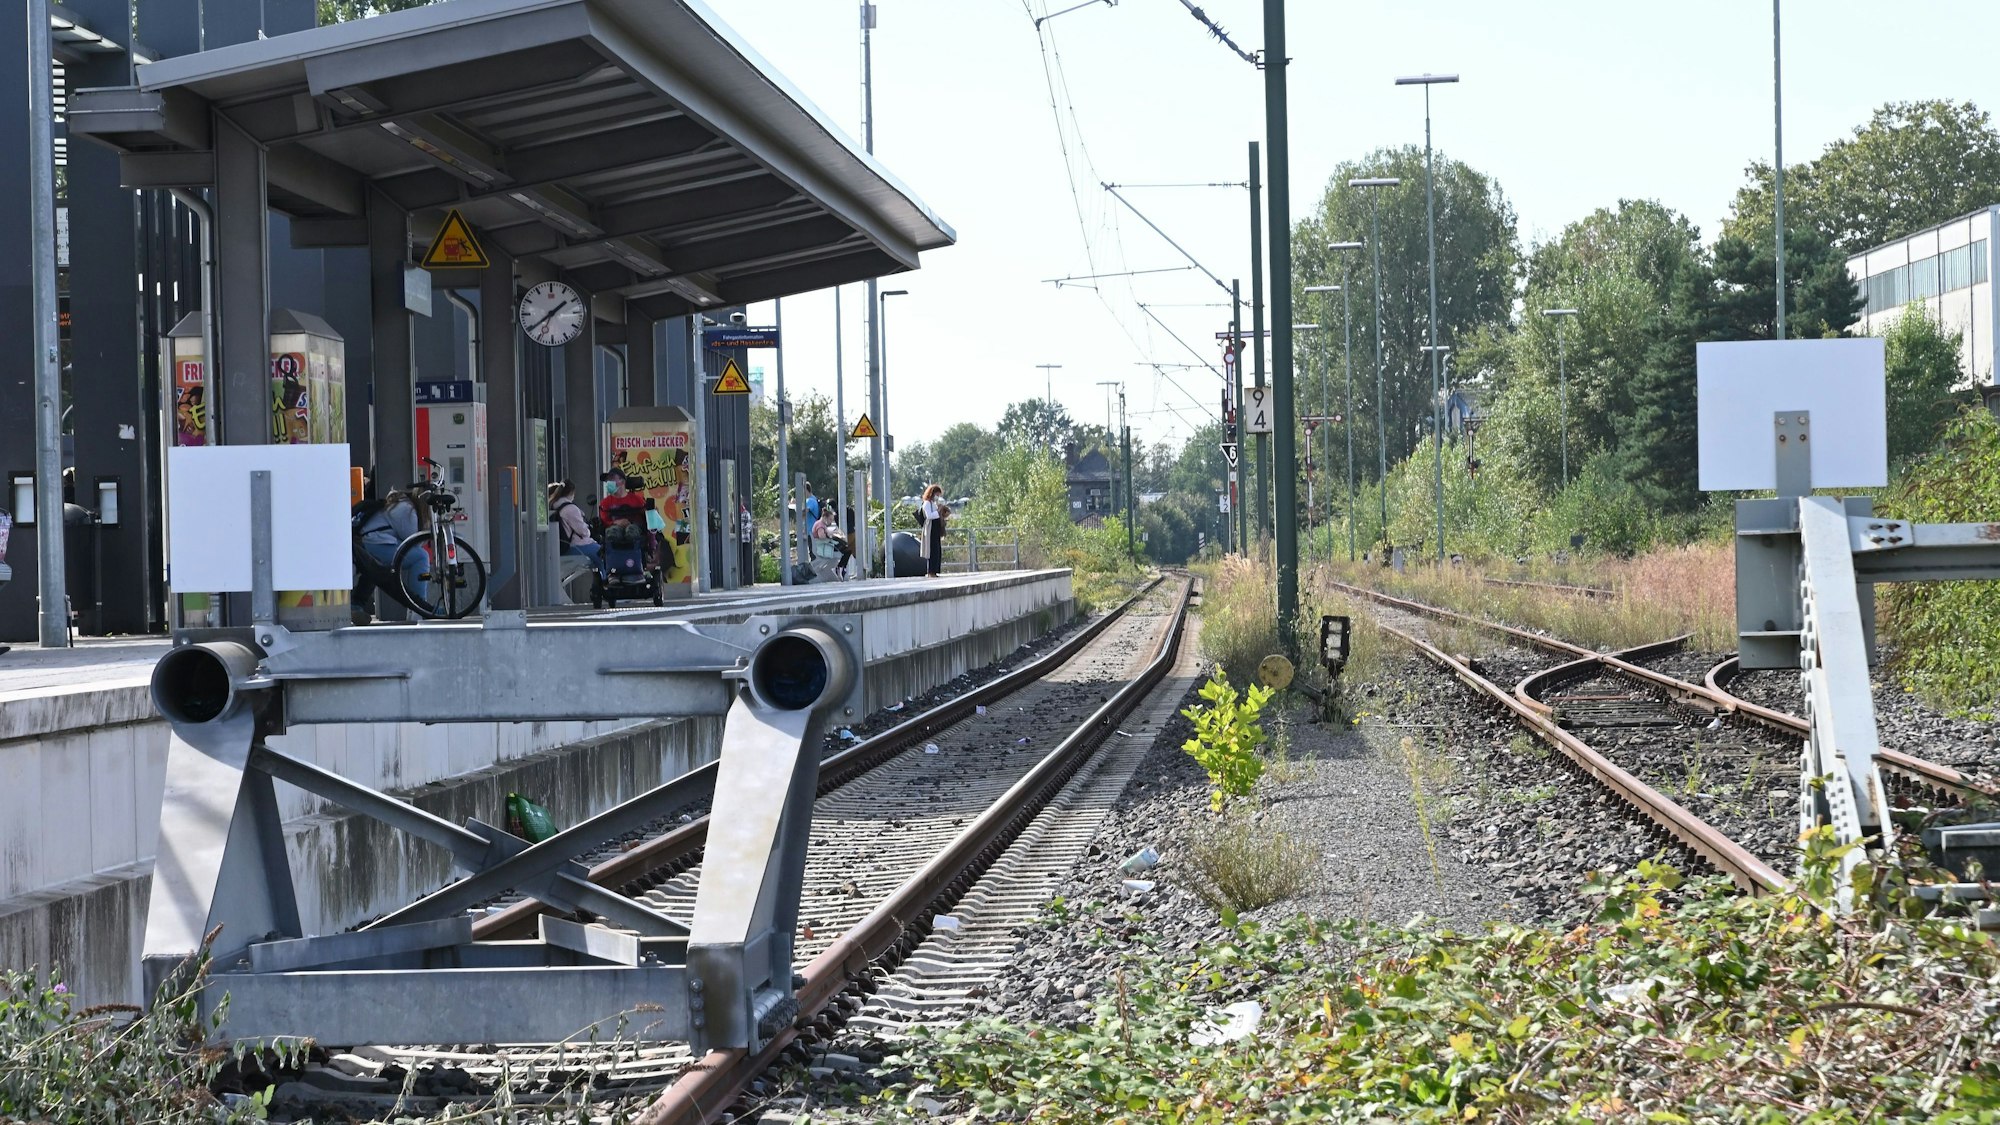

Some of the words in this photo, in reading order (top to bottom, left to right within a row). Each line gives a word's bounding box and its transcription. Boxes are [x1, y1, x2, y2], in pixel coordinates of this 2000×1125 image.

[184, 363, 205, 381] FRI
[1252, 389, 1264, 408] 9
[1253, 410, 1266, 429] 4
[616, 437, 640, 448] FRISCH
[643, 437, 656, 447] und
[658, 436, 684, 447] LECKER
[1229, 446, 1236, 460] 6
[619, 456, 677, 477] Einfach
[1223, 503, 1229, 512] 2
